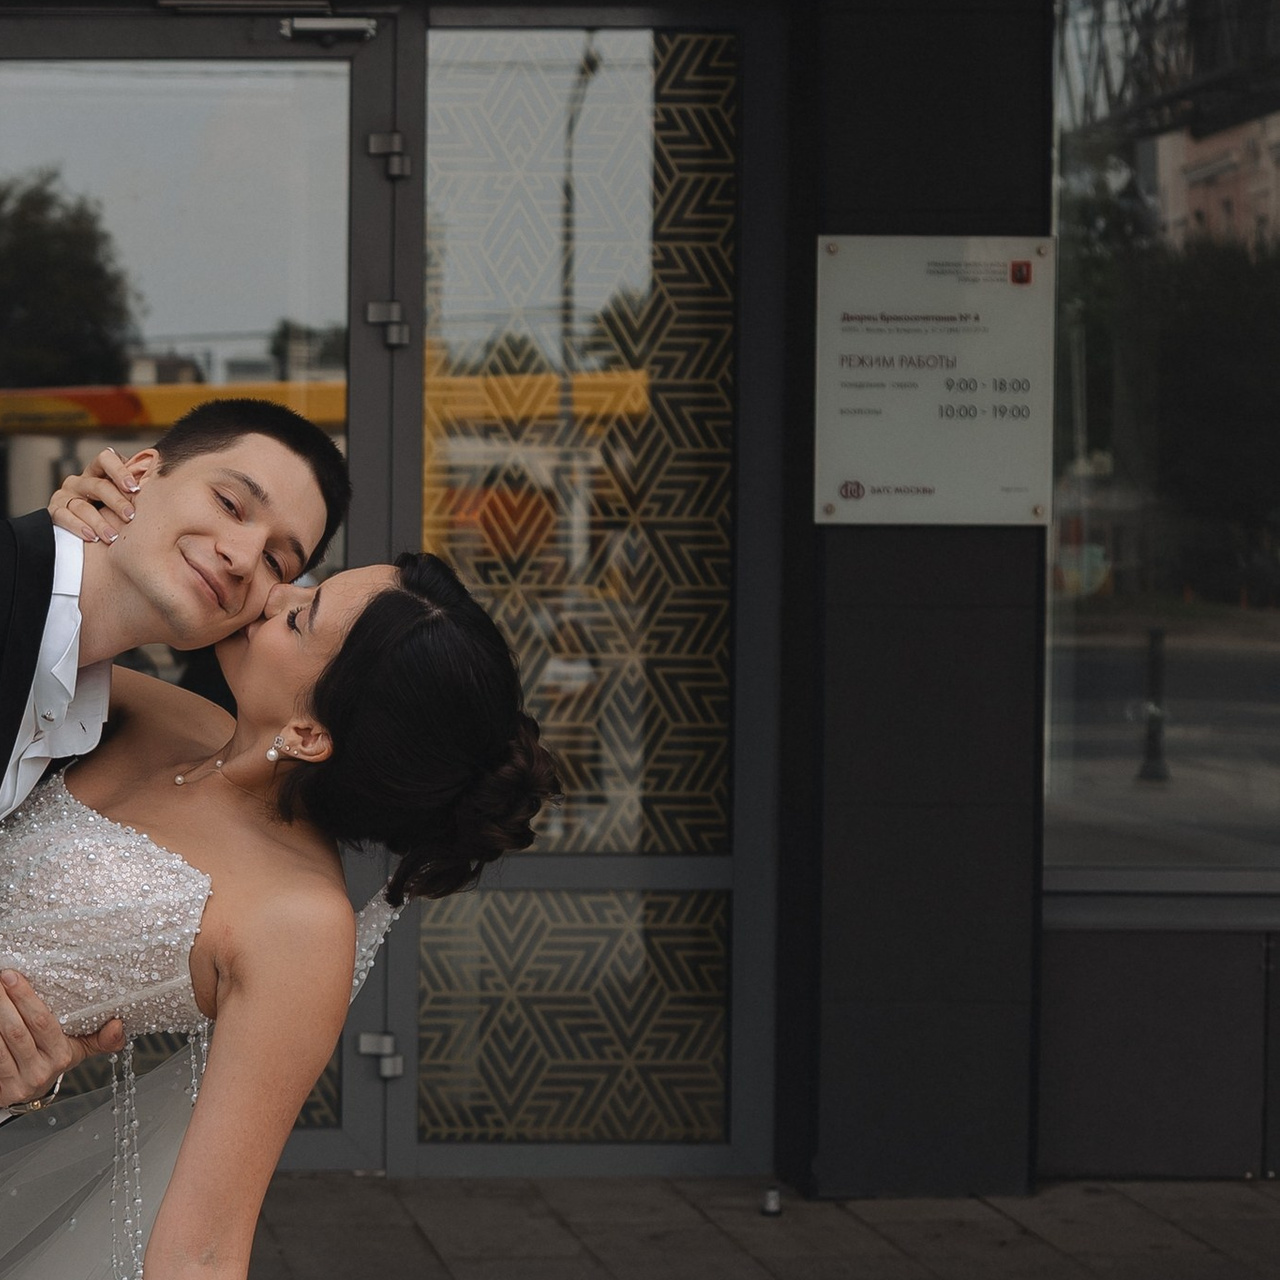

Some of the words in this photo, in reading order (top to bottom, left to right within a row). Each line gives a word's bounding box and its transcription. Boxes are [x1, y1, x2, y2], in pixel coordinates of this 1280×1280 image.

[840, 354, 895, 368] РЕЖИМ
[900, 354, 958, 369] РАБОТЫ
[945, 377, 978, 392] 9:00
[992, 377, 1031, 393] 18:00
[938, 404, 978, 419] 10:00
[992, 404, 1031, 419] 19:00
